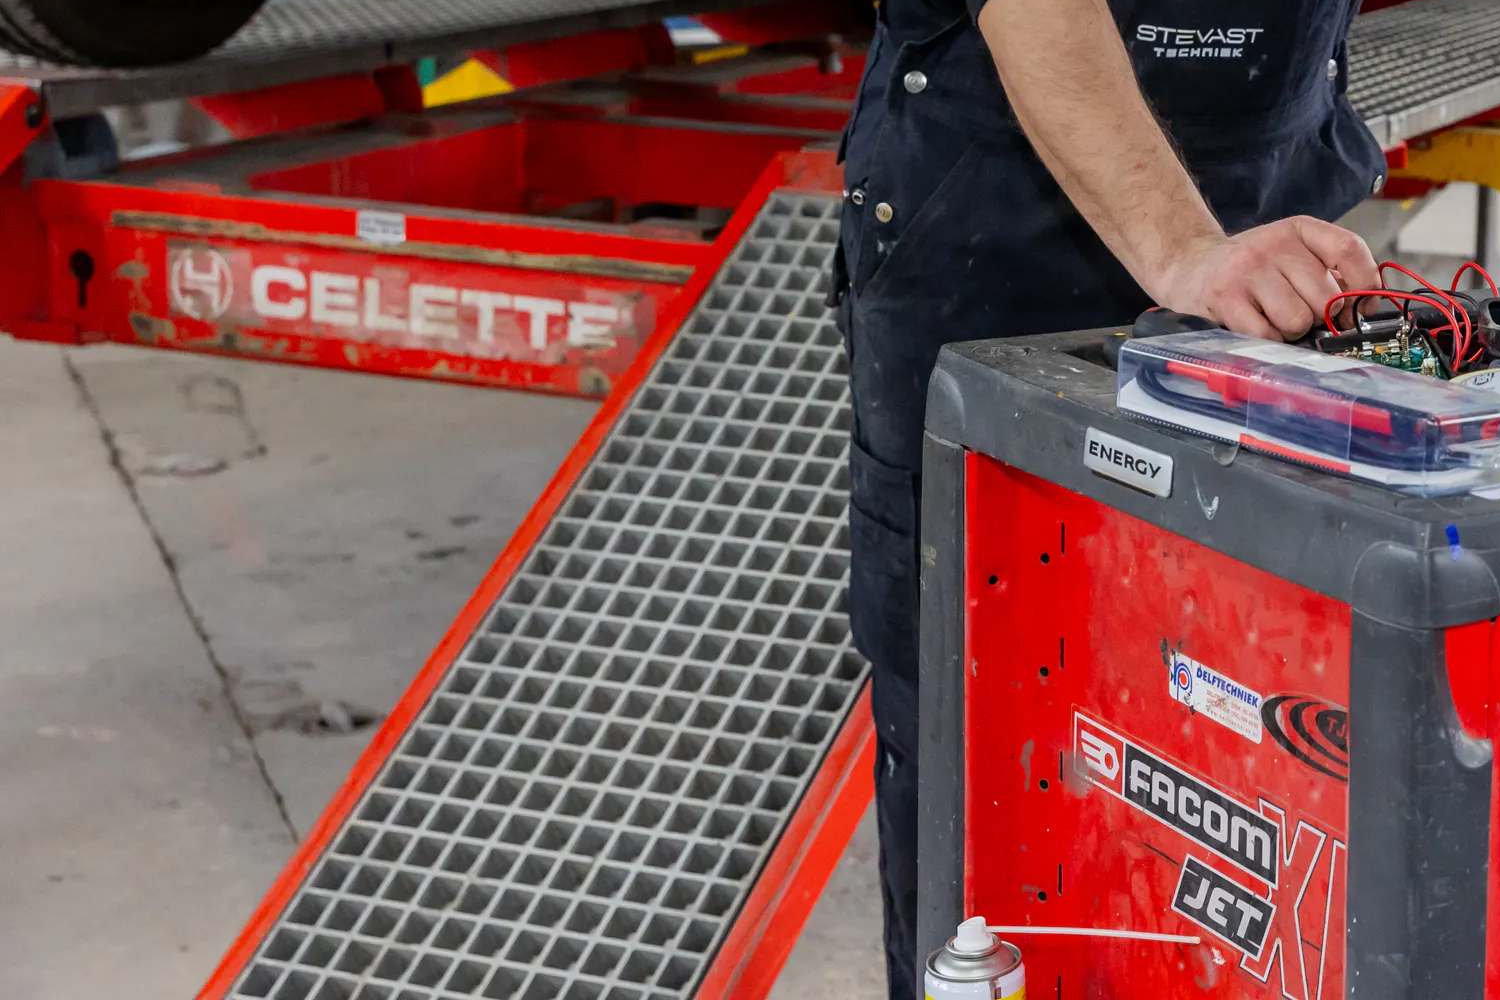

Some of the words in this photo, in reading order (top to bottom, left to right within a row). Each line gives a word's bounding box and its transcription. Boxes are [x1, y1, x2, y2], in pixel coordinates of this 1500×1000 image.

[1136, 24, 1264, 45] STEVAST
[1154, 47, 1243, 58] TECHNIEK
[250, 264, 620, 350] CELETTE
[1089, 440, 1161, 479] ENERGY
[1196, 667, 1259, 708] DELFTECHNIEK
[1130, 760, 1271, 870] FACOM
[1183, 878, 1263, 939] JET
